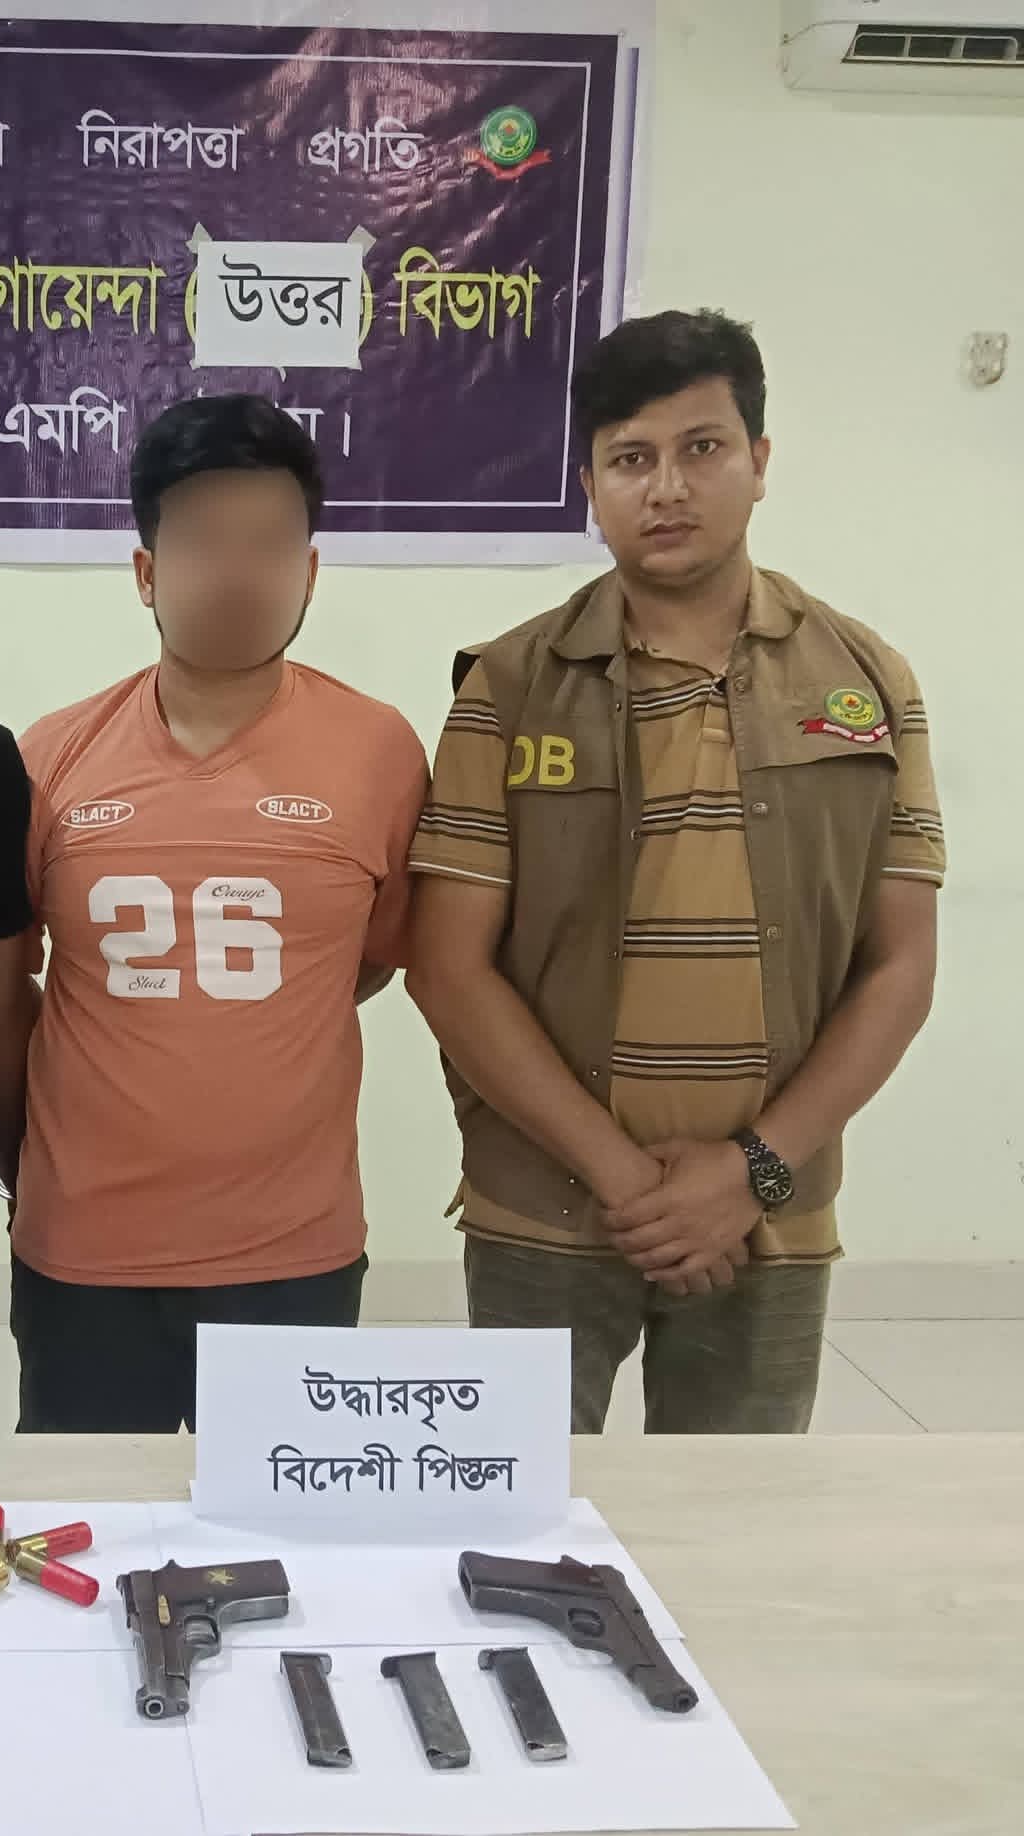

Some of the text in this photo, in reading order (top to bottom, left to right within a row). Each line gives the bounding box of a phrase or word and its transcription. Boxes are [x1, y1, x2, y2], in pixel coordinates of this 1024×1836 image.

[76, 109, 246, 171] নিরাপত্তা
[307, 116, 425, 175] প্রগতি
[394, 247, 540, 340] বিভাগ
[88, 875, 284, 1001] 26
[301, 1365, 485, 1432] উদ্ধারকৃত
[266, 1443, 519, 1493] বিদেশী পিস্তল
